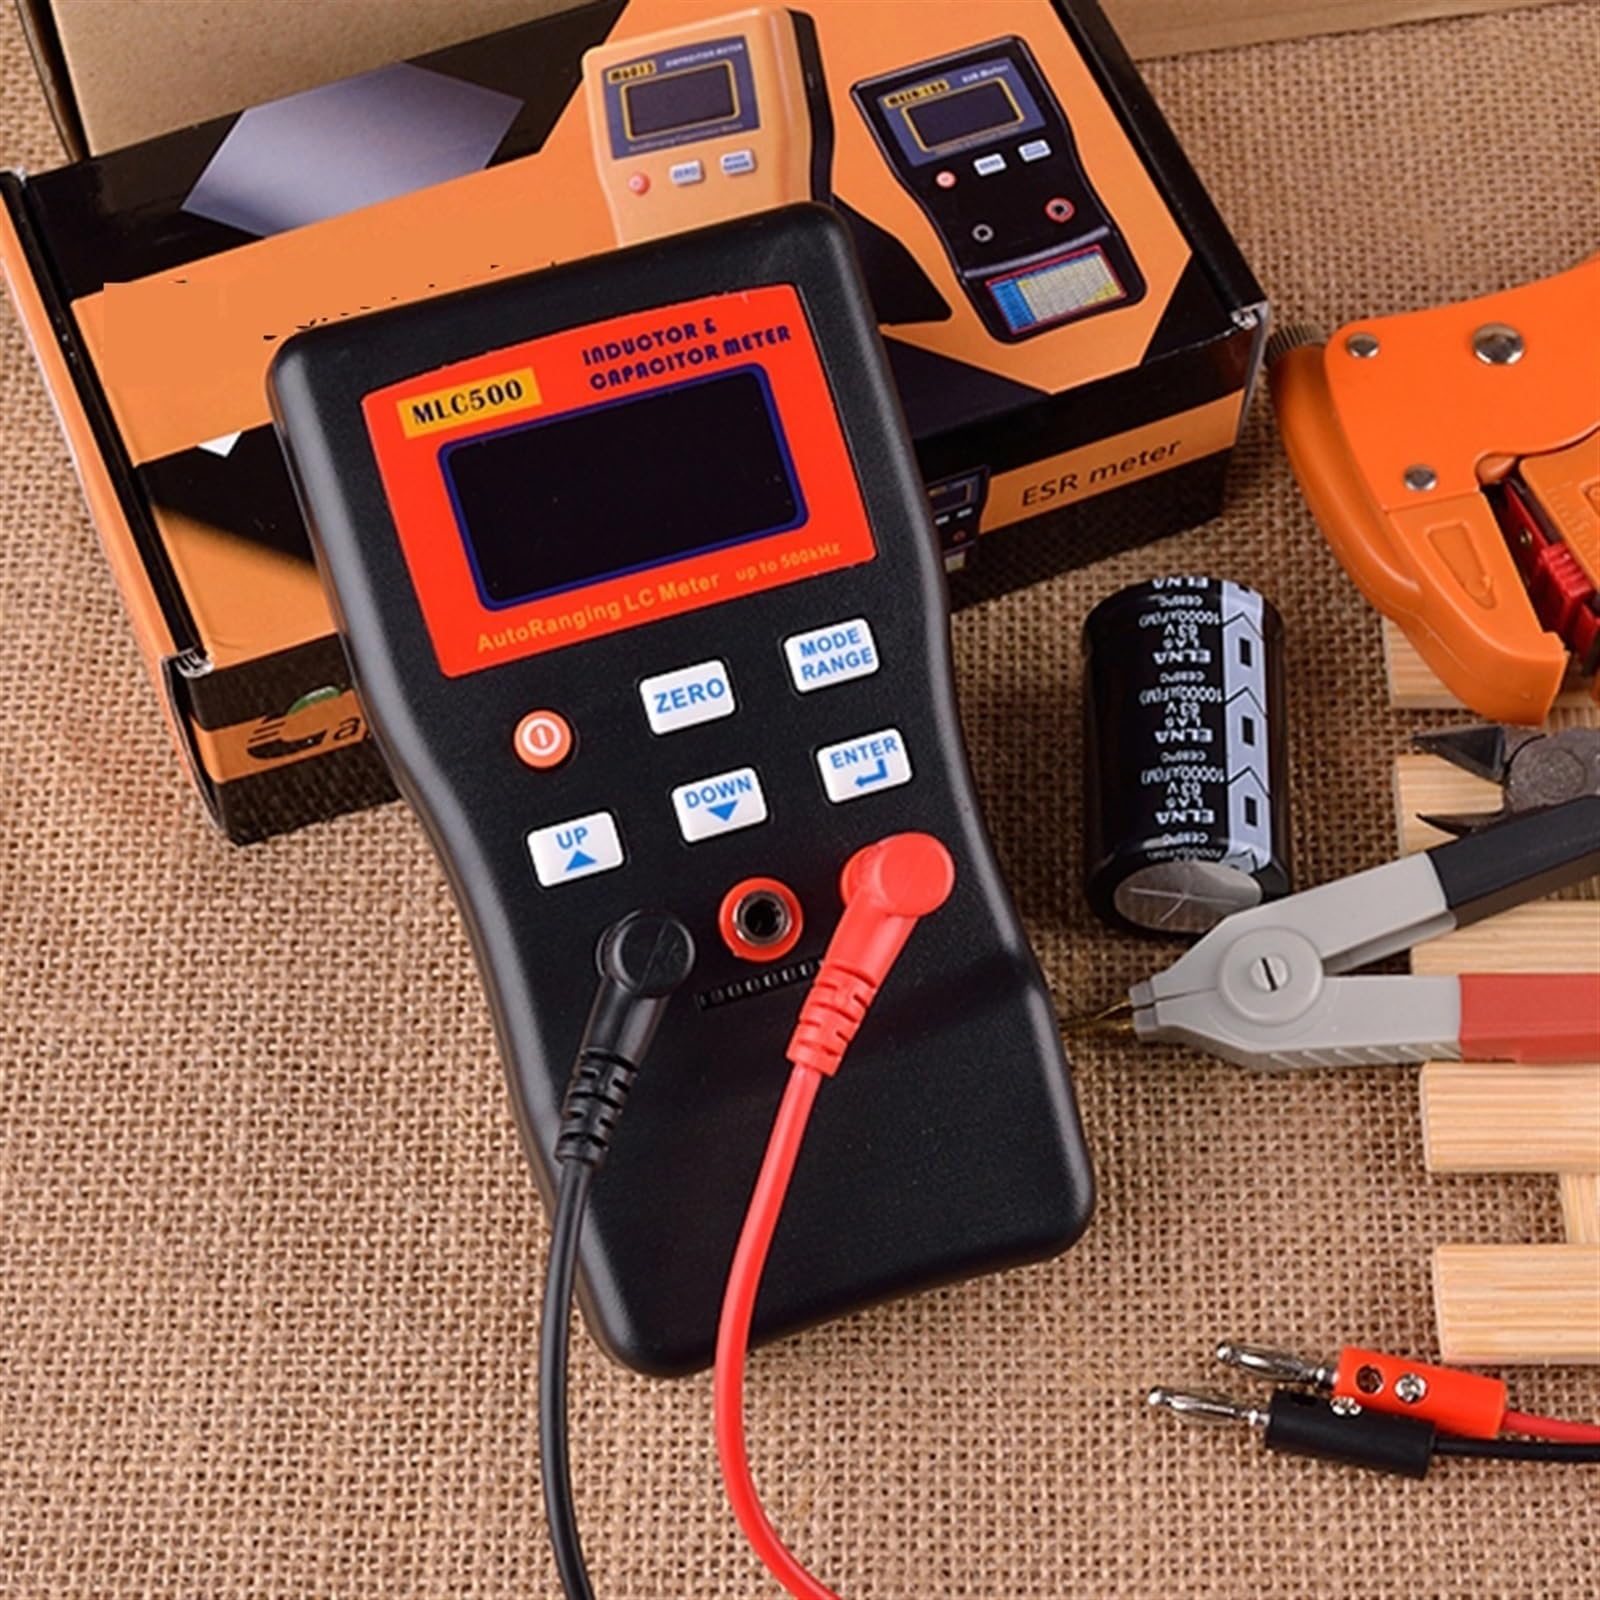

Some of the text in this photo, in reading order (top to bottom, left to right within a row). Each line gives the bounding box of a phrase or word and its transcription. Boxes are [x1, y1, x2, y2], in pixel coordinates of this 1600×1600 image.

[582, 318, 717, 366] INDUCTOR &
[589, 325, 791, 391] CAPACITOR METER
[412, 379, 524, 425] MLC500
[1021, 439, 1181, 507] ESR meter
[477, 542, 842, 653] AutoRanging LC Meter up to 500kHz
[799, 627, 861, 658] MODE
[1153, 649, 1212, 665] ELNA
[801, 646, 874, 682] RANGE
[653, 677, 726, 714] ZERO
[830, 736, 899, 769] ENTER
[1154, 728, 1213, 744] ELNA
[684, 776, 753, 809] DOWN
[1155, 808, 1215, 825] ELNA
[555, 827, 589, 851] UP
